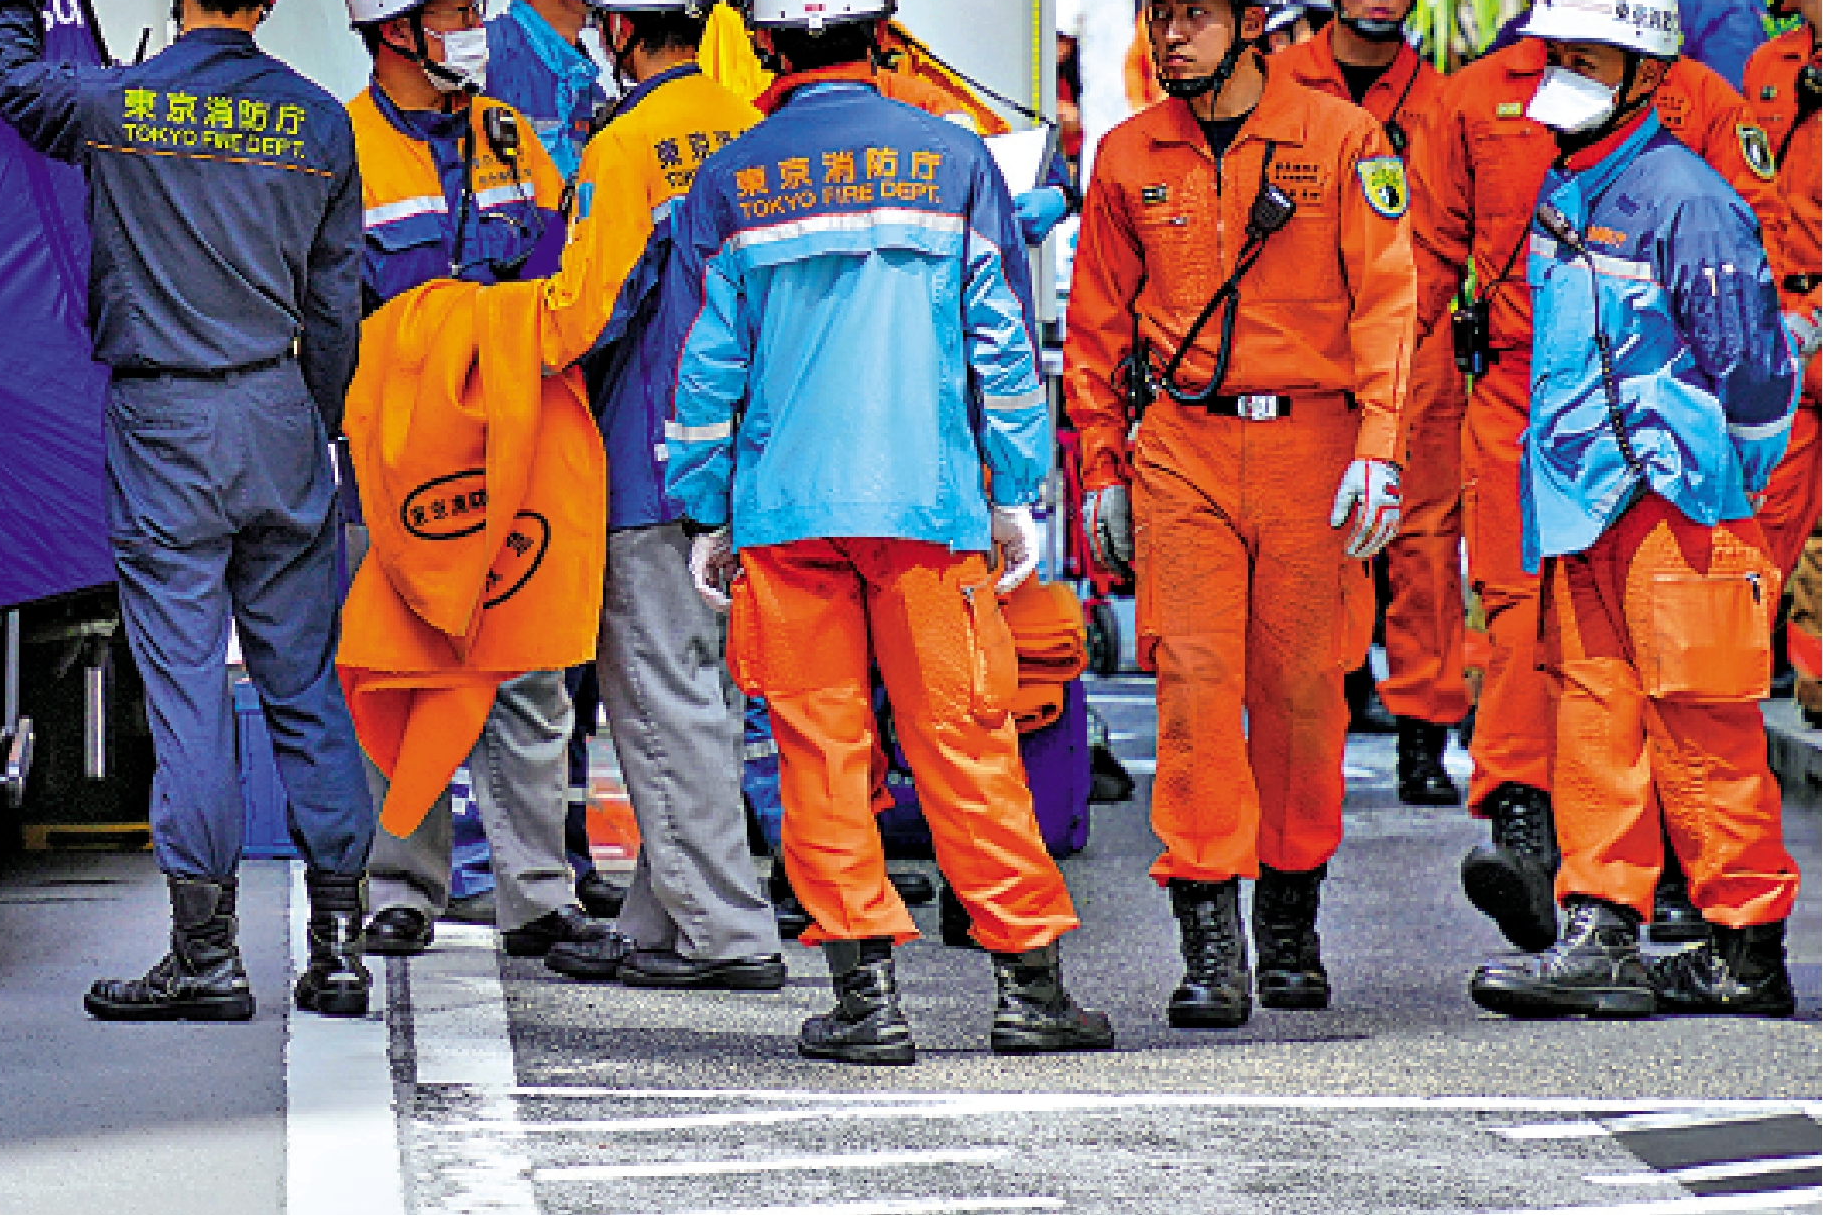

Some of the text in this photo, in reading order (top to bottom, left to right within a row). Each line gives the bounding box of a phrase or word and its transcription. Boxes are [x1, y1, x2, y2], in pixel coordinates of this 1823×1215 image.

[122, 86, 307, 135] 東京消防庁
[122, 123, 198, 146] TOKYO
[733, 146, 944, 198] 東京消防庁
[739, 189, 818, 221] TOKYO
[821, 182, 875, 207] FIRE
